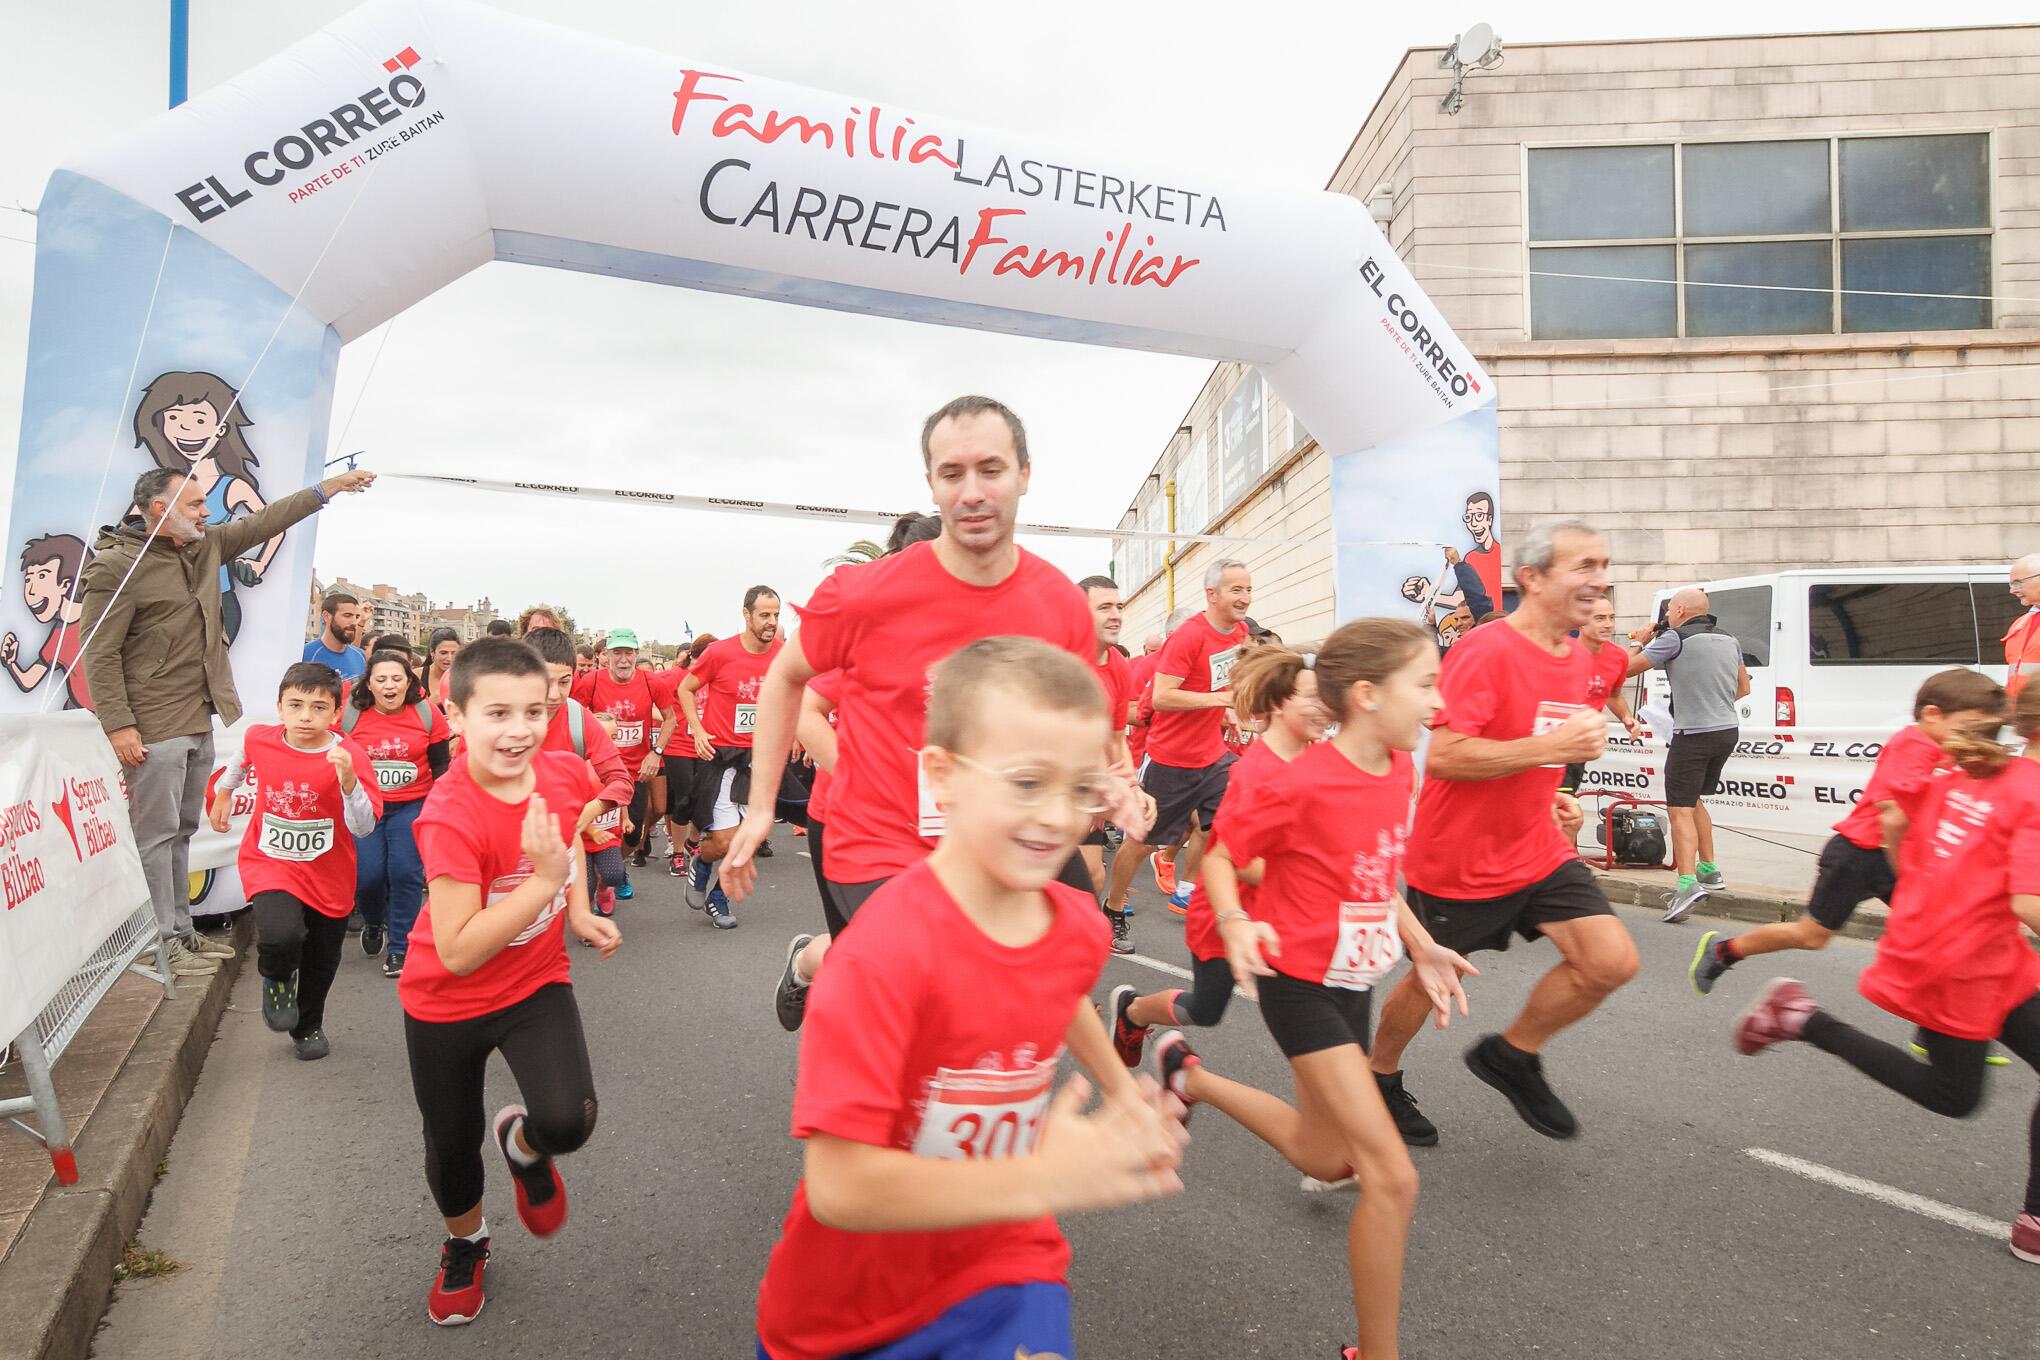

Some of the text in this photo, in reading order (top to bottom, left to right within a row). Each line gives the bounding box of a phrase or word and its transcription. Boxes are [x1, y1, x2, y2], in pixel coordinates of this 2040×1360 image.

[175, 74, 426, 223] EL CORREO
[288, 110, 445, 204] PARTE DE TI ZURE BAITAN
[671, 69, 1227, 232] Familia LASTERKETA
[960, 207, 1200, 288] Familiar
[1359, 256, 1468, 397] EL CORREO
[1380, 317, 1454, 409] PARTE DE TI ZURE BAITAN
[617, 728, 639, 740] 012
[740, 712, 757, 726] 20
[1736, 741, 1784, 755] REO
[1810, 742, 1840, 757] EL
[71, 776, 110, 815] Seguros
[1701, 798, 1790, 811] NFORMAZIO BALIOTSUA
[1715, 780, 1787, 800] ORREO
[1814, 786, 1846, 805] EL
[82, 816, 117, 857] Bilbao
[268, 827, 326, 852] 2006
[1, 853, 46, 911] Bilbao
